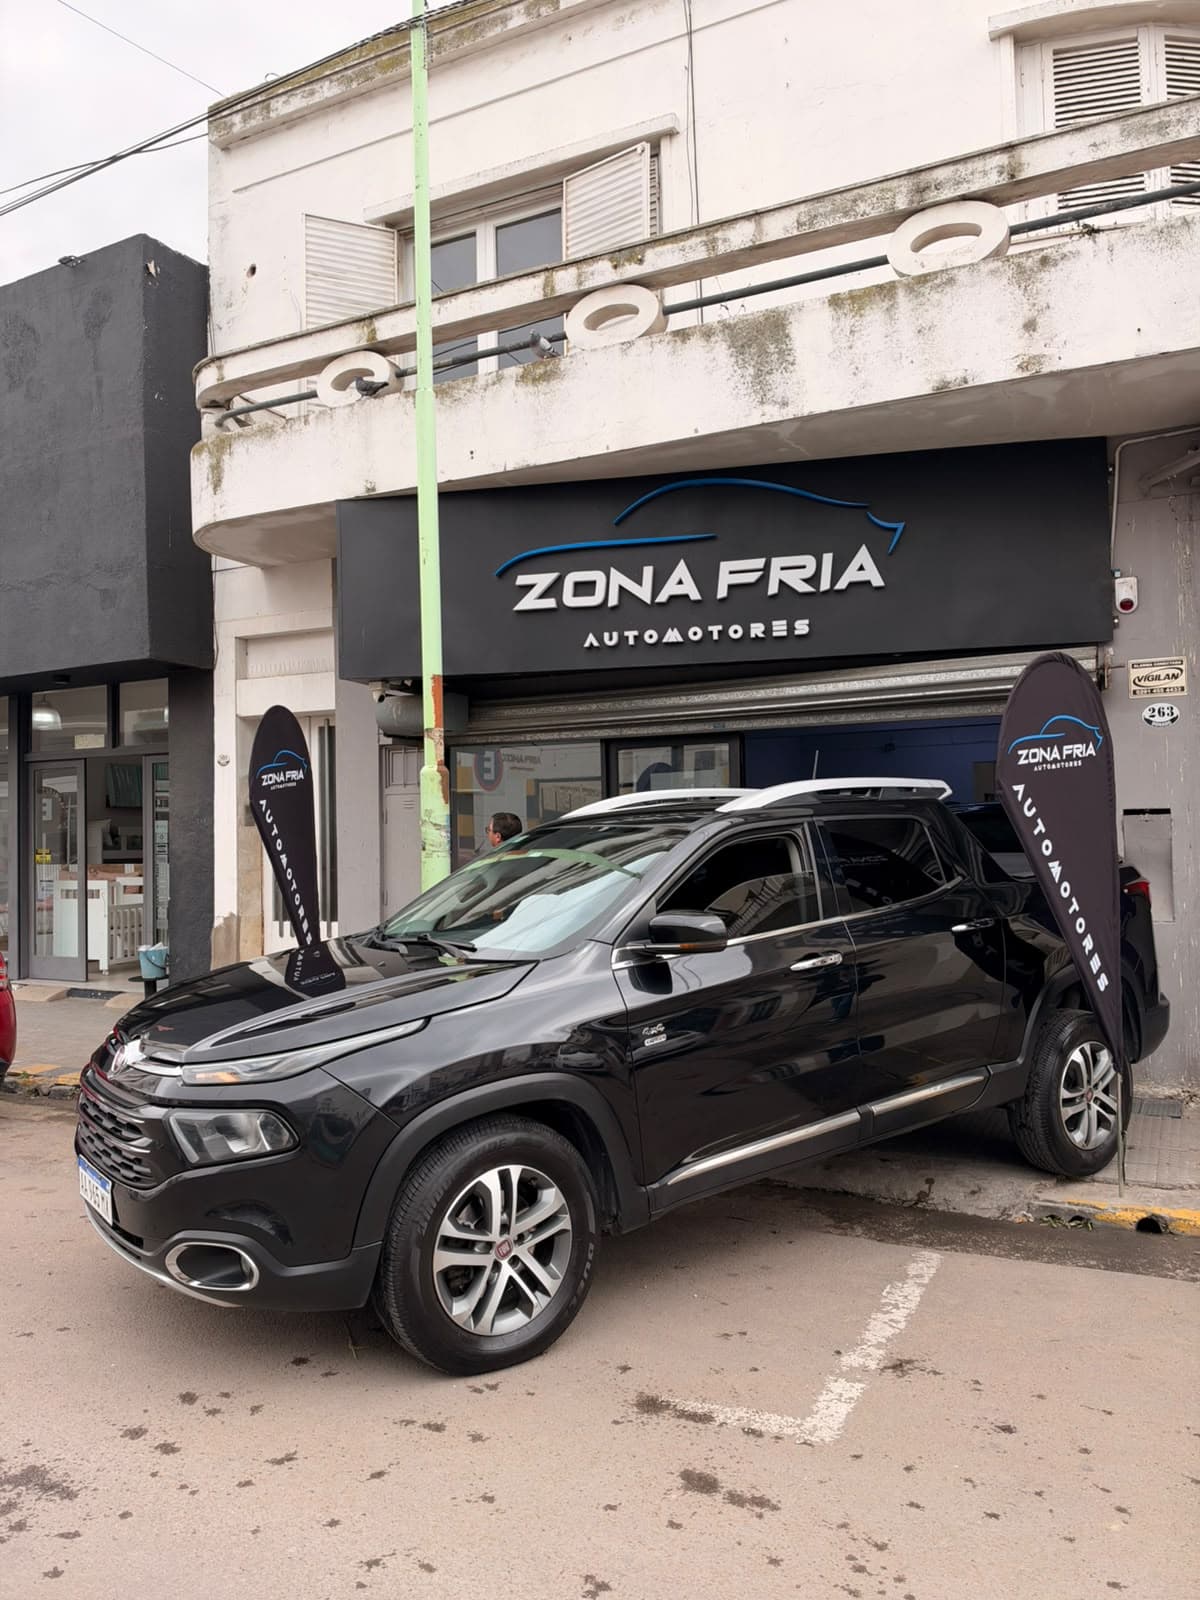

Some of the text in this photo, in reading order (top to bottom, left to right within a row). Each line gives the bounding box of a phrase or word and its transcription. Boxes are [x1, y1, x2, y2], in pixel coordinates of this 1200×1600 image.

[512, 543, 886, 611] ZONA FRIA
[583, 618, 810, 648] AUTOMOTORES
[1148, 705, 1174, 717] 263
[1017, 741, 1097, 765] ZONA FRIA
[261, 771, 285, 786] ZONA
[285, 768, 305, 782] FRIA
[1012, 784, 1108, 993] AUTOMOTORES
